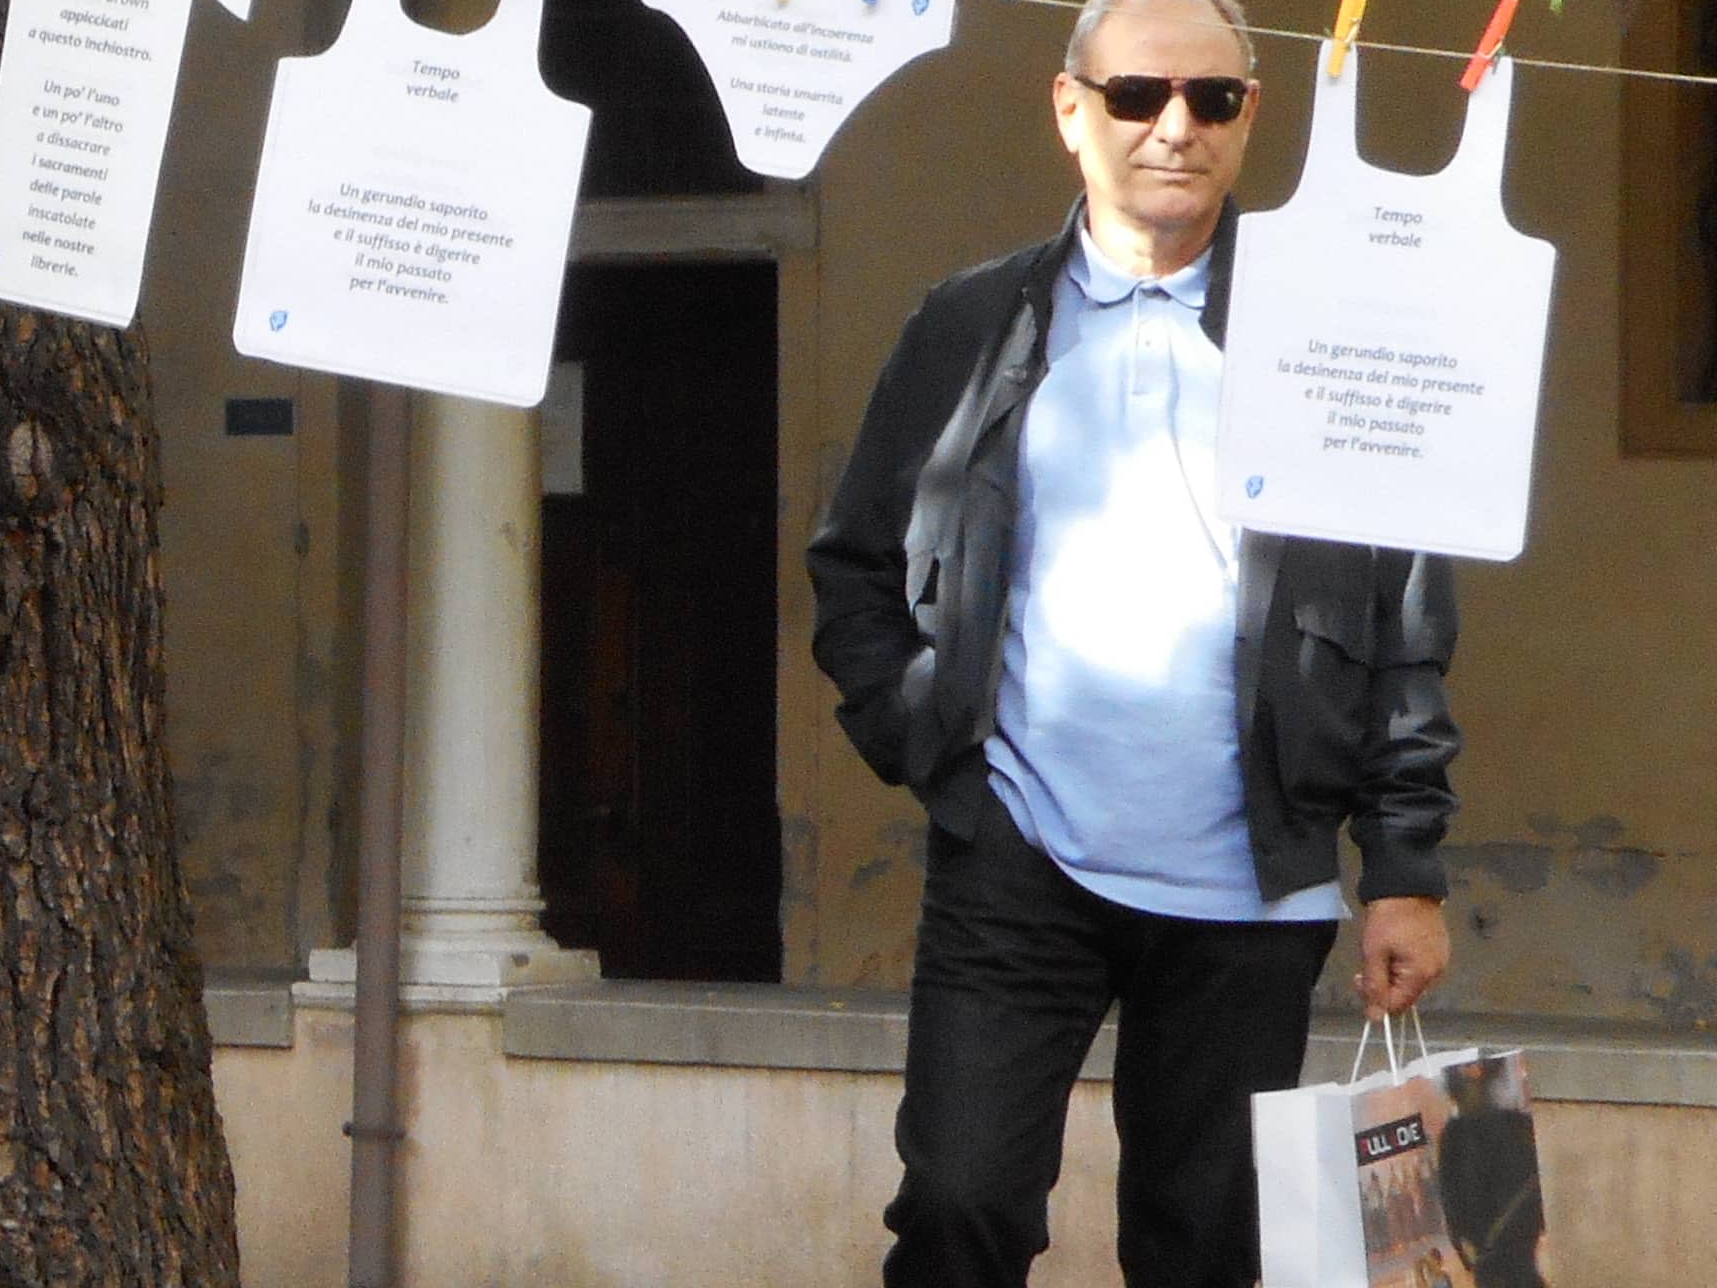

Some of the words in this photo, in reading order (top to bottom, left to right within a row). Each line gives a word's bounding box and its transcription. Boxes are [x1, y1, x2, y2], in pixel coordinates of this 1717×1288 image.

[59, 9, 129, 31] appiccicati
[793, 22, 874, 44] all'incoerenza
[28, 28, 37, 39] a
[39, 30, 82, 48] questo
[85, 36, 152, 62] inchiostro.
[731, 34, 748, 46] mi
[749, 39, 794, 54] ustiono
[795, 43, 809, 56] di
[809, 48, 853, 63] ostilità.
[413, 60, 461, 82] Tempo
[43, 80, 61, 96] Un
[63, 86, 85, 100] po'
[86, 88, 120, 107] l'uno
[406, 84, 459, 103] verbale
[730, 76, 755, 92] Una
[756, 83, 791, 98] storia
[792, 88, 843, 105] smarrita
[32, 105, 41, 117] e
[42, 106, 59, 119] un
[60, 111, 84, 125] po'
[83, 112, 123, 133] l'altro
[762, 104, 805, 122] latente
[36, 132, 45, 143] a
[47, 131, 111, 156] dissacrare
[754, 126, 763, 136] e
[31, 152, 37, 166] i
[38, 158, 109, 181] sacramenti
[29, 178, 60, 197] delle
[61, 188, 102, 206] parole
[340, 183, 360, 199] Un
[360, 189, 426, 211] gerundio
[429, 201, 488, 221] saporito
[28, 203, 96, 230] inscatolate
[307, 198, 321, 214] la
[323, 202, 394, 227] desinenza
[396, 215, 419, 231] del
[421, 222, 449, 237] mio
[450, 228, 514, 248] presente
[1373, 206, 1423, 226] Tempo
[22, 230, 52, 246] nelle
[54, 238, 95, 255] nostre
[333, 230, 343, 240] e
[345, 228, 355, 242] il
[357, 232, 410, 252] suffisso
[413, 240, 423, 254] è
[425, 243, 481, 264] digerire
[1368, 230, 1422, 248] verbale
[30, 254, 78, 277] librerie.
[355, 252, 365, 267] il
[366, 256, 394, 272] mio
[395, 262, 452, 283] passato
[349, 276, 376, 290] per
[377, 278, 449, 303] l'avvenire.
[1308, 339, 1328, 354] Un
[1329, 345, 1395, 363] gerundio
[1397, 352, 1458, 370] saporito
[1277, 358, 1291, 373] la
[1293, 360, 1364, 382] desinenza
[1366, 368, 1389, 384] del
[1391, 373, 1419, 388] mio
[1420, 378, 1485, 396] presente
[1304, 388, 1314, 400] e
[1316, 386, 1326, 400] il
[1327, 388, 1382, 408] suffisso
[1385, 394, 1394, 408] è
[1396, 396, 1453, 416] digerire
[1327, 410, 1337, 425] il
[1339, 413, 1367, 429] mio
[1368, 417, 1425, 436] passato
[1322, 435, 1350, 450] per
[1350, 435, 1424, 458] l'avvenire.
